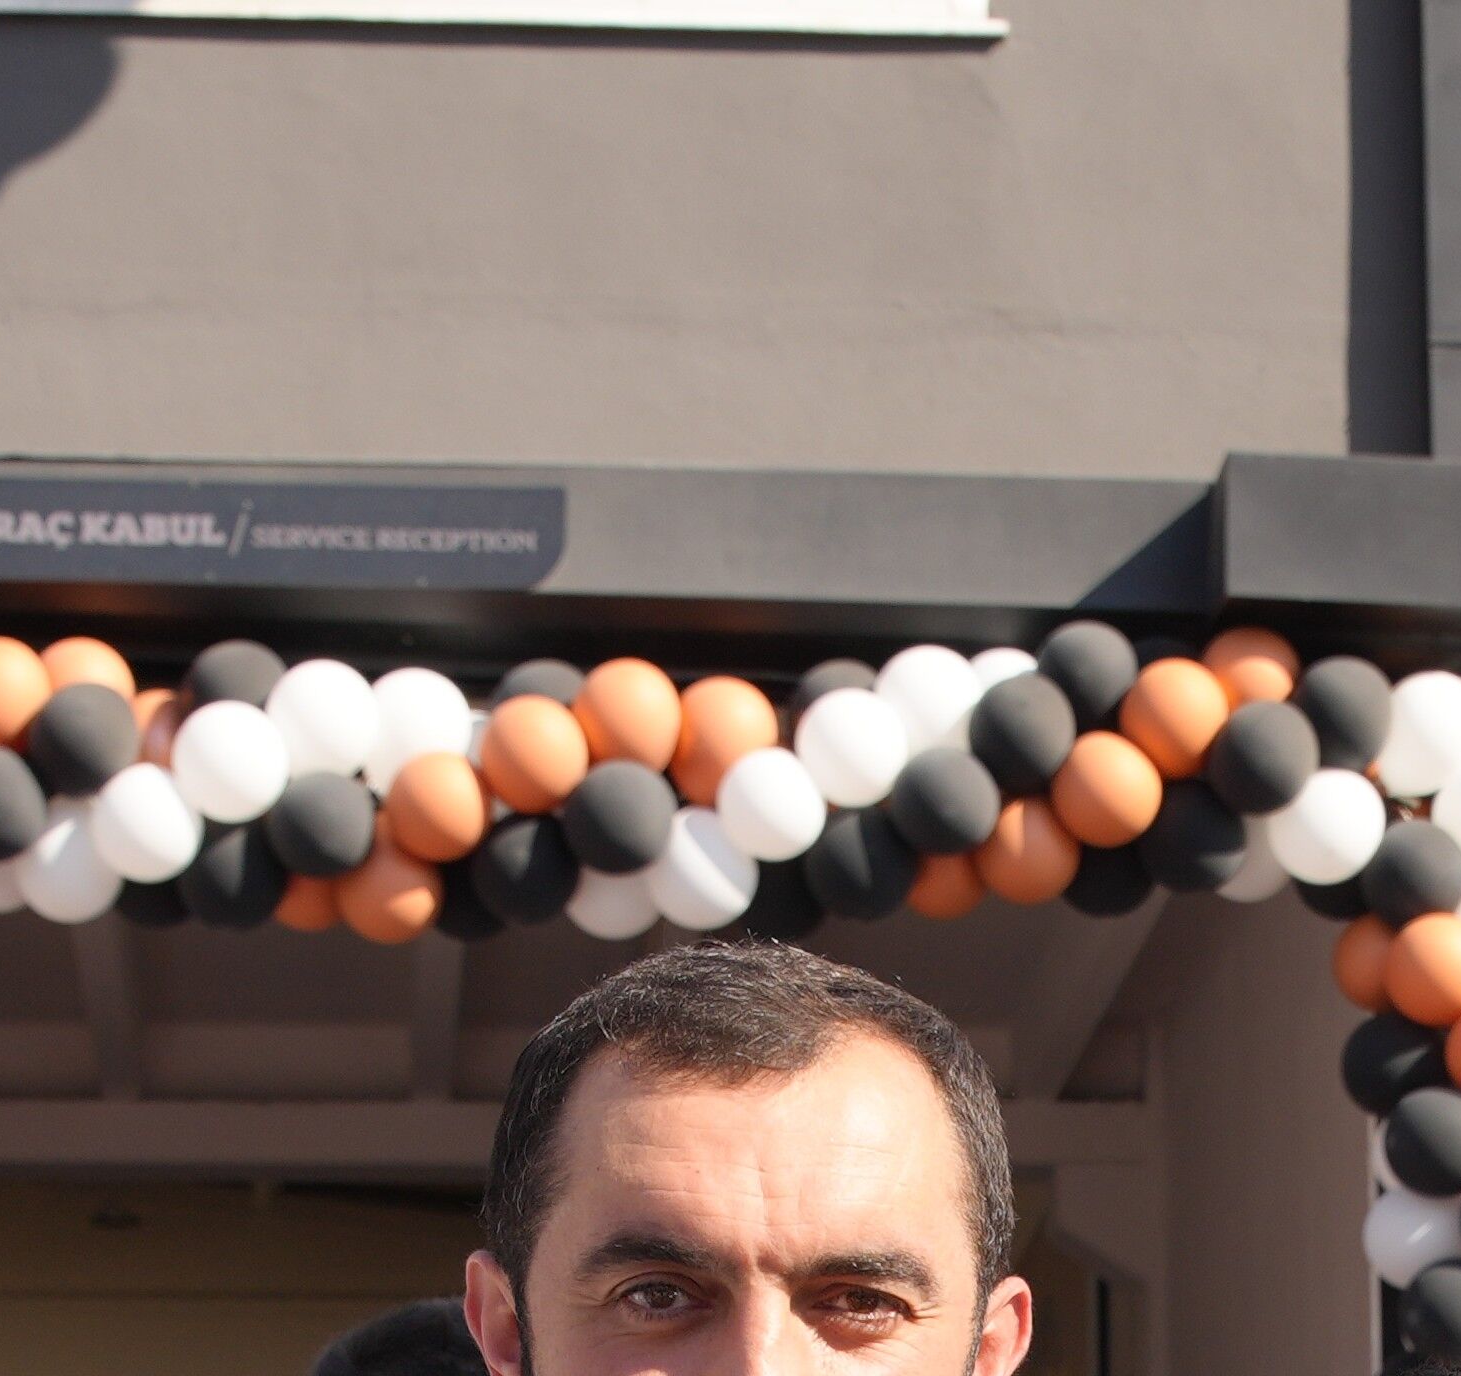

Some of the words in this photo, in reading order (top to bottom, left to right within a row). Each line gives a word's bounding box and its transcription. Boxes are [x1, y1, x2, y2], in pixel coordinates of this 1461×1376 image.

[78, 511, 228, 547] KABUL
[250, 523, 372, 551] SERVICE
[375, 525, 538, 553] RECEPTION
